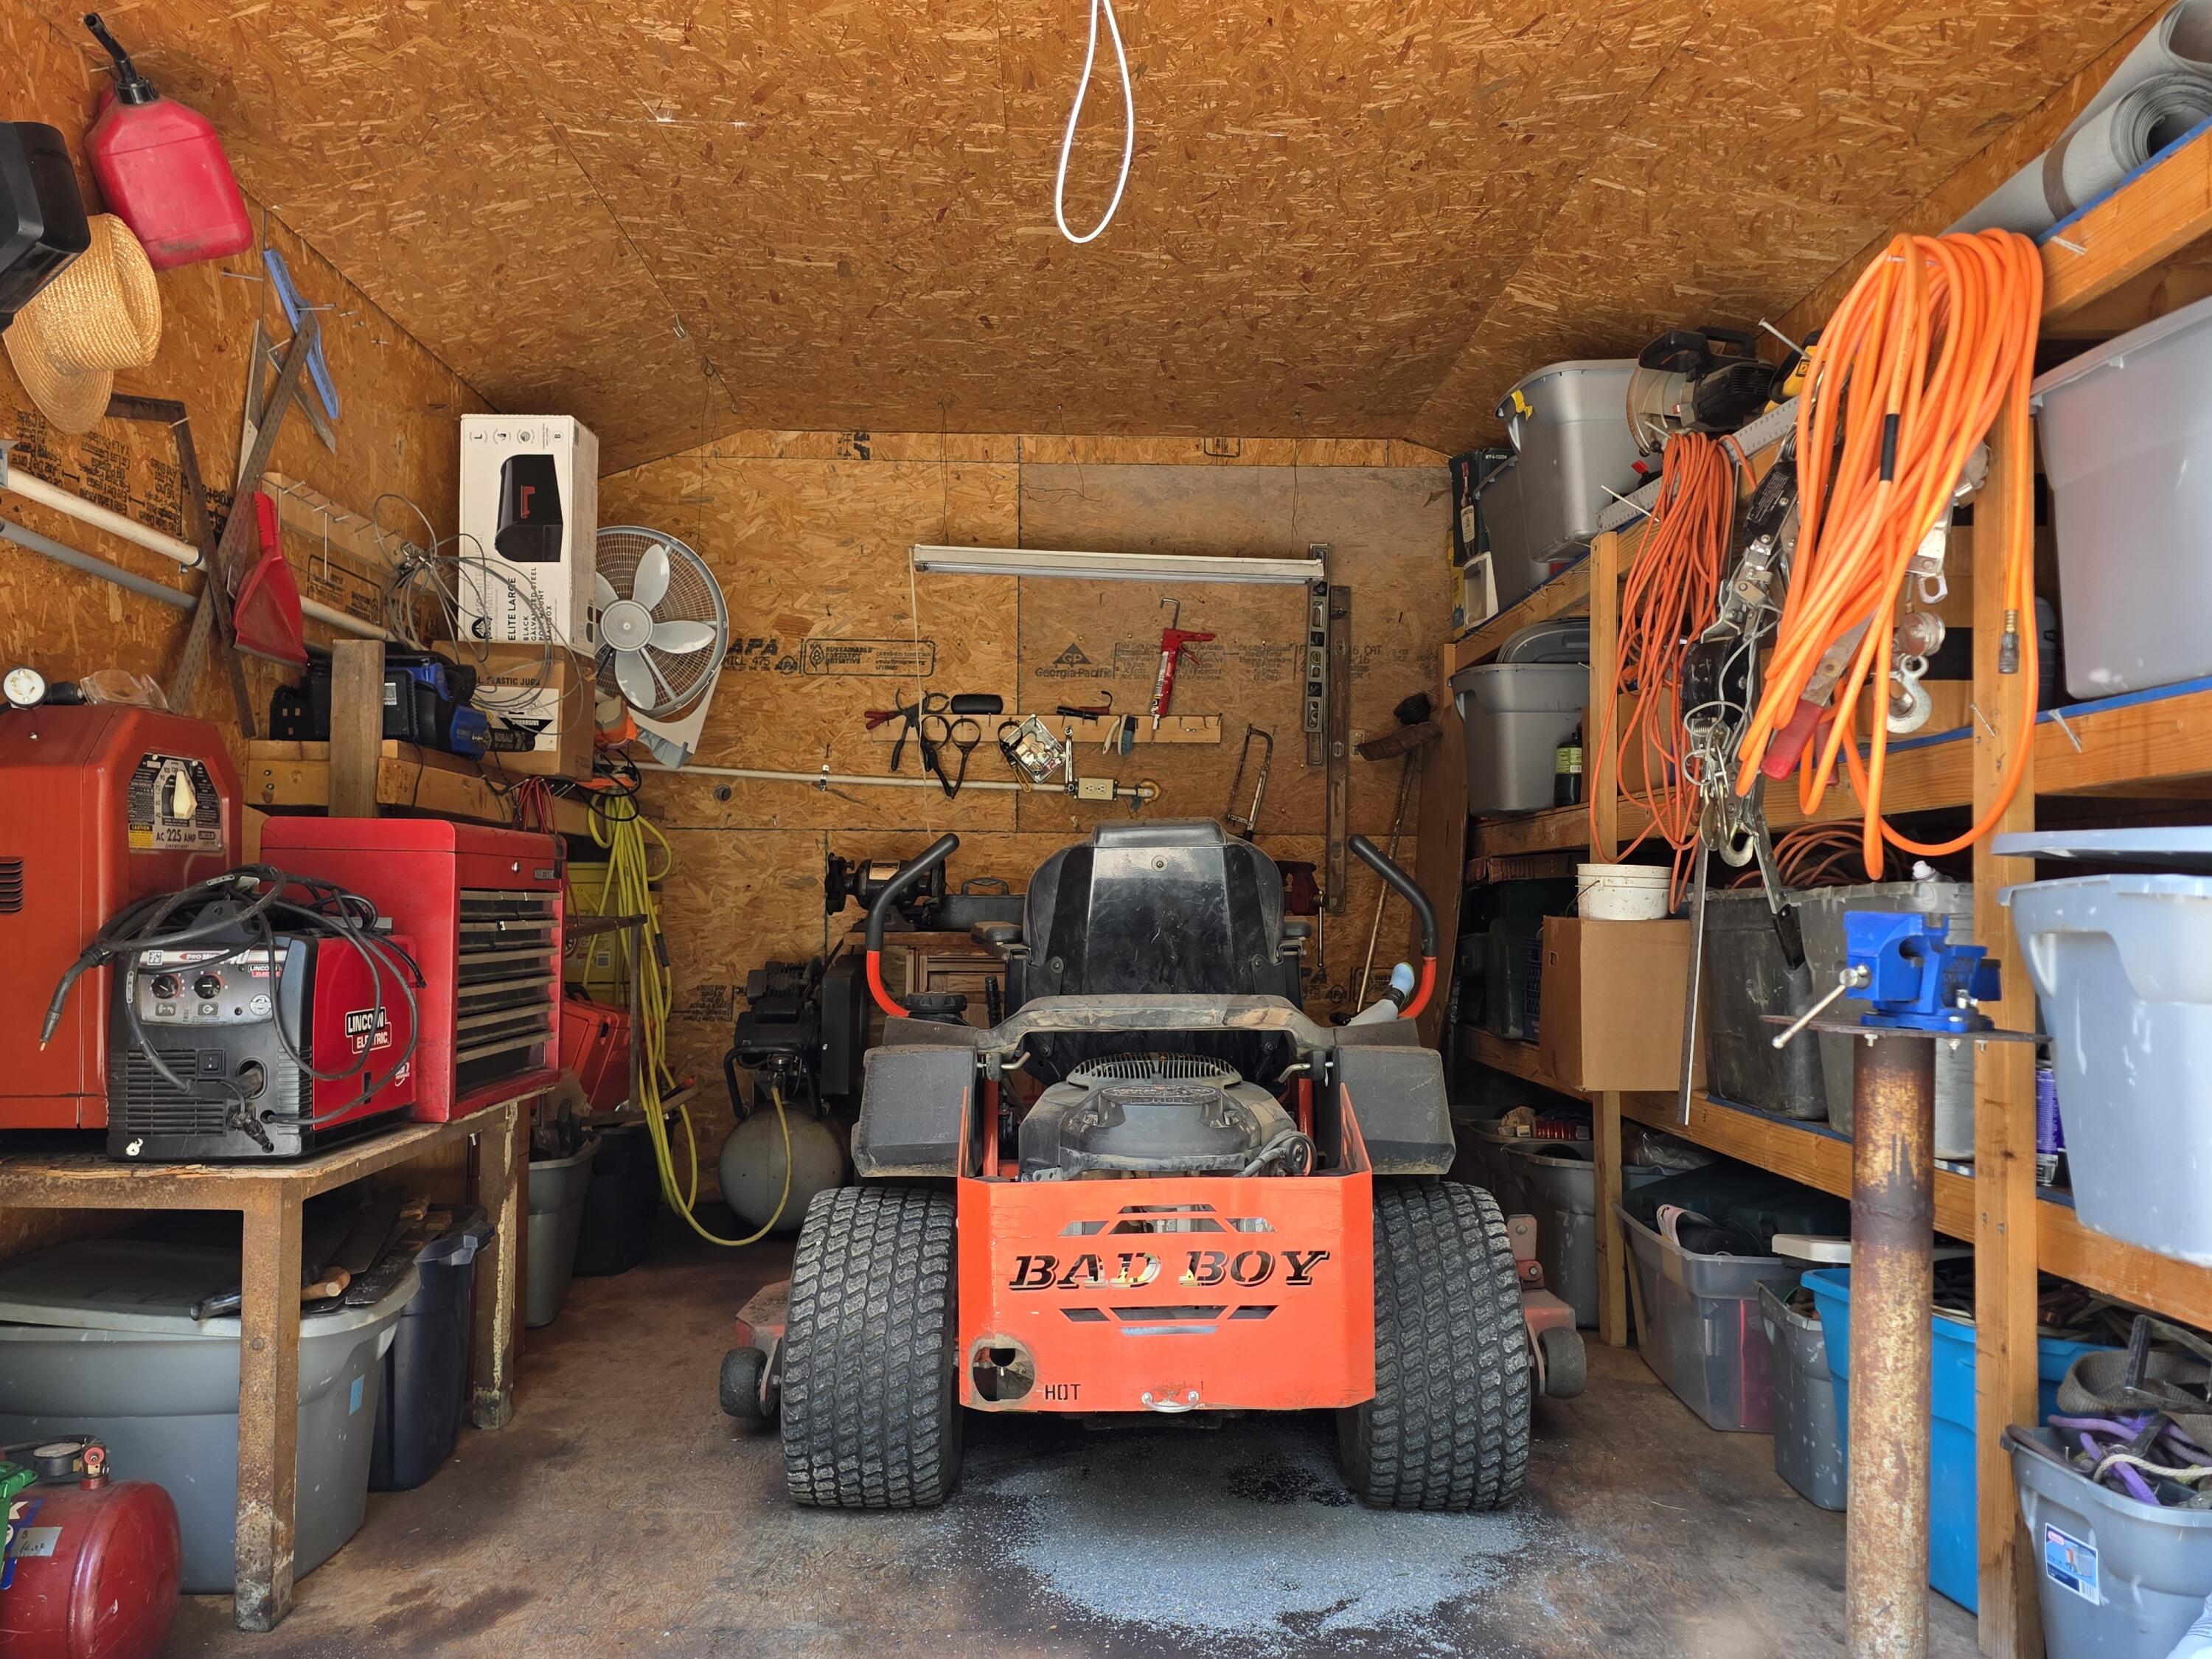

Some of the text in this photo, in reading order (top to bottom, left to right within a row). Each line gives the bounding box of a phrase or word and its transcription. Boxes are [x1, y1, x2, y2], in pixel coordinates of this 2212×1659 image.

[508, 613, 516, 641] ELITE
[726, 638, 778, 655] APA
[1061, 653, 1083, 664] GP
[1034, 667, 1112, 679] Georgia-Pacific
[156, 832, 164, 841] AC
[167, 828, 181, 842] 225
[184, 834, 196, 842] AMP
[347, 1011, 384, 1033] LINCON
[356, 1032, 389, 1049] ELETRIC
[1008, 1250, 1331, 1292] BAD BOY
[1044, 1383, 1082, 1401] HOT
